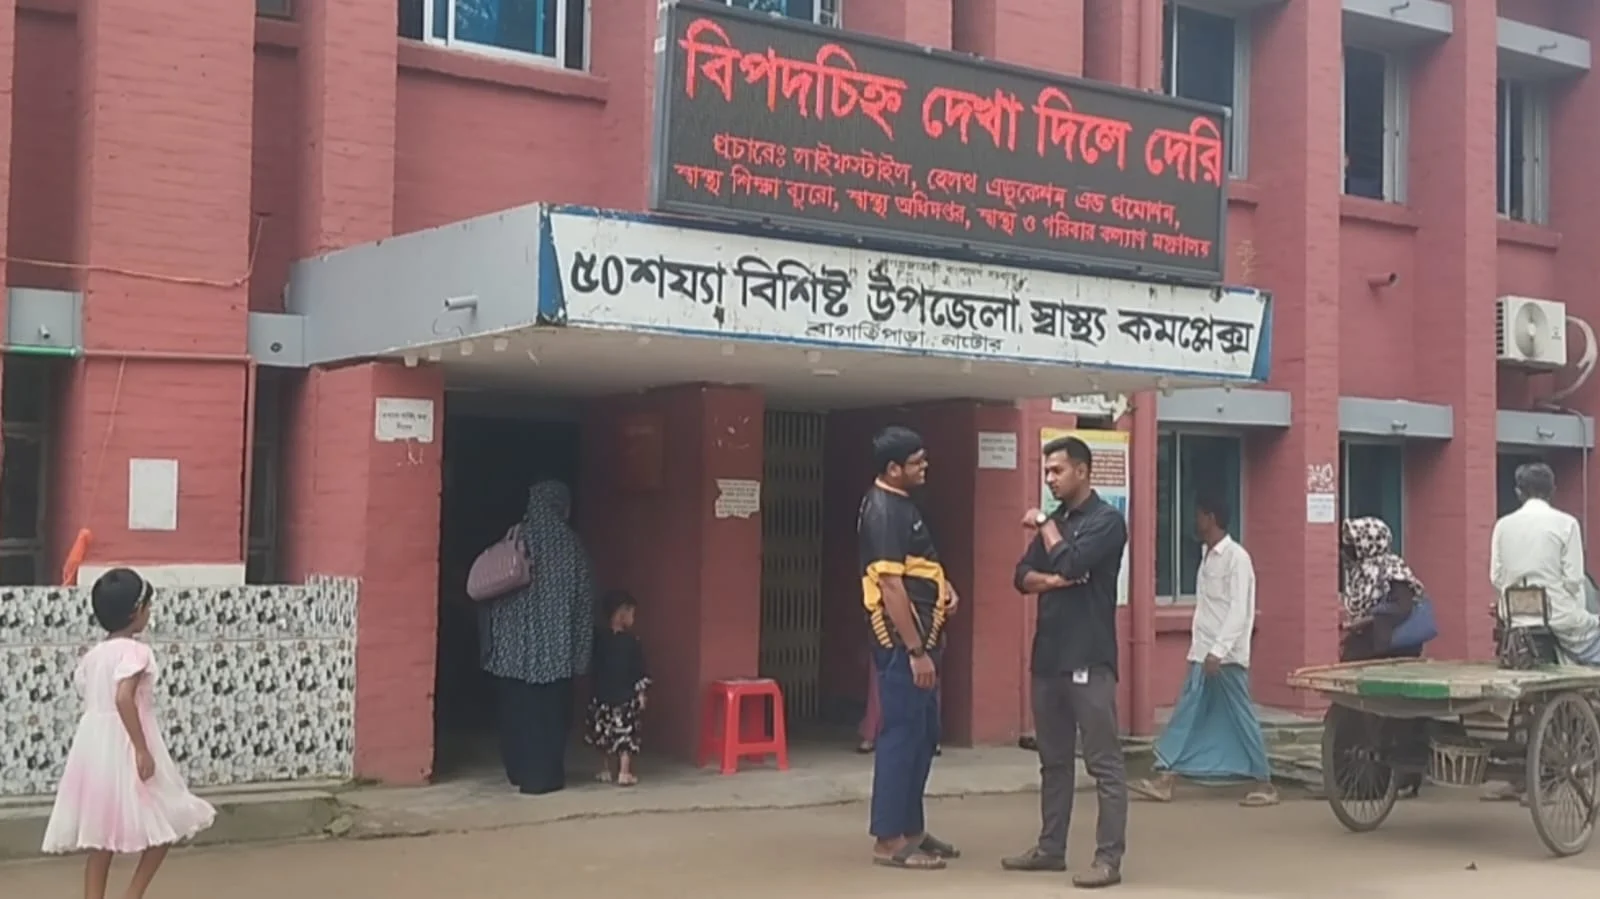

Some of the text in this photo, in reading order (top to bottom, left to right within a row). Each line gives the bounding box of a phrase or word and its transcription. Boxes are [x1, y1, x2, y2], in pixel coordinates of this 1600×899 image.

[922, 86, 1024, 152] দেখা
[1032, 86, 1132, 170] দিলে
[1145, 115, 1223, 188] দেরি
[927, 167, 978, 197] হেলথ
[674, 164, 723, 197] স্বাস্থ্য
[731, 163, 781, 200] শিক্ষা
[846, 188, 890, 218] স্বাস্থ্য
[976, 206, 1018, 236] স্বাস্থ্য
[1022, 215, 1036, 232] ও
[1043, 210, 1095, 242] পরিবার
[1099, 225, 1148, 251] কল্যাণ
[733, 254, 852, 317] বিশিষ্ট
[867, 264, 1021, 334] উপজেলা
[1030, 298, 1107, 348] স্বাস্থ্য
[1117, 308, 1254, 353] কমপ্লেক্স
